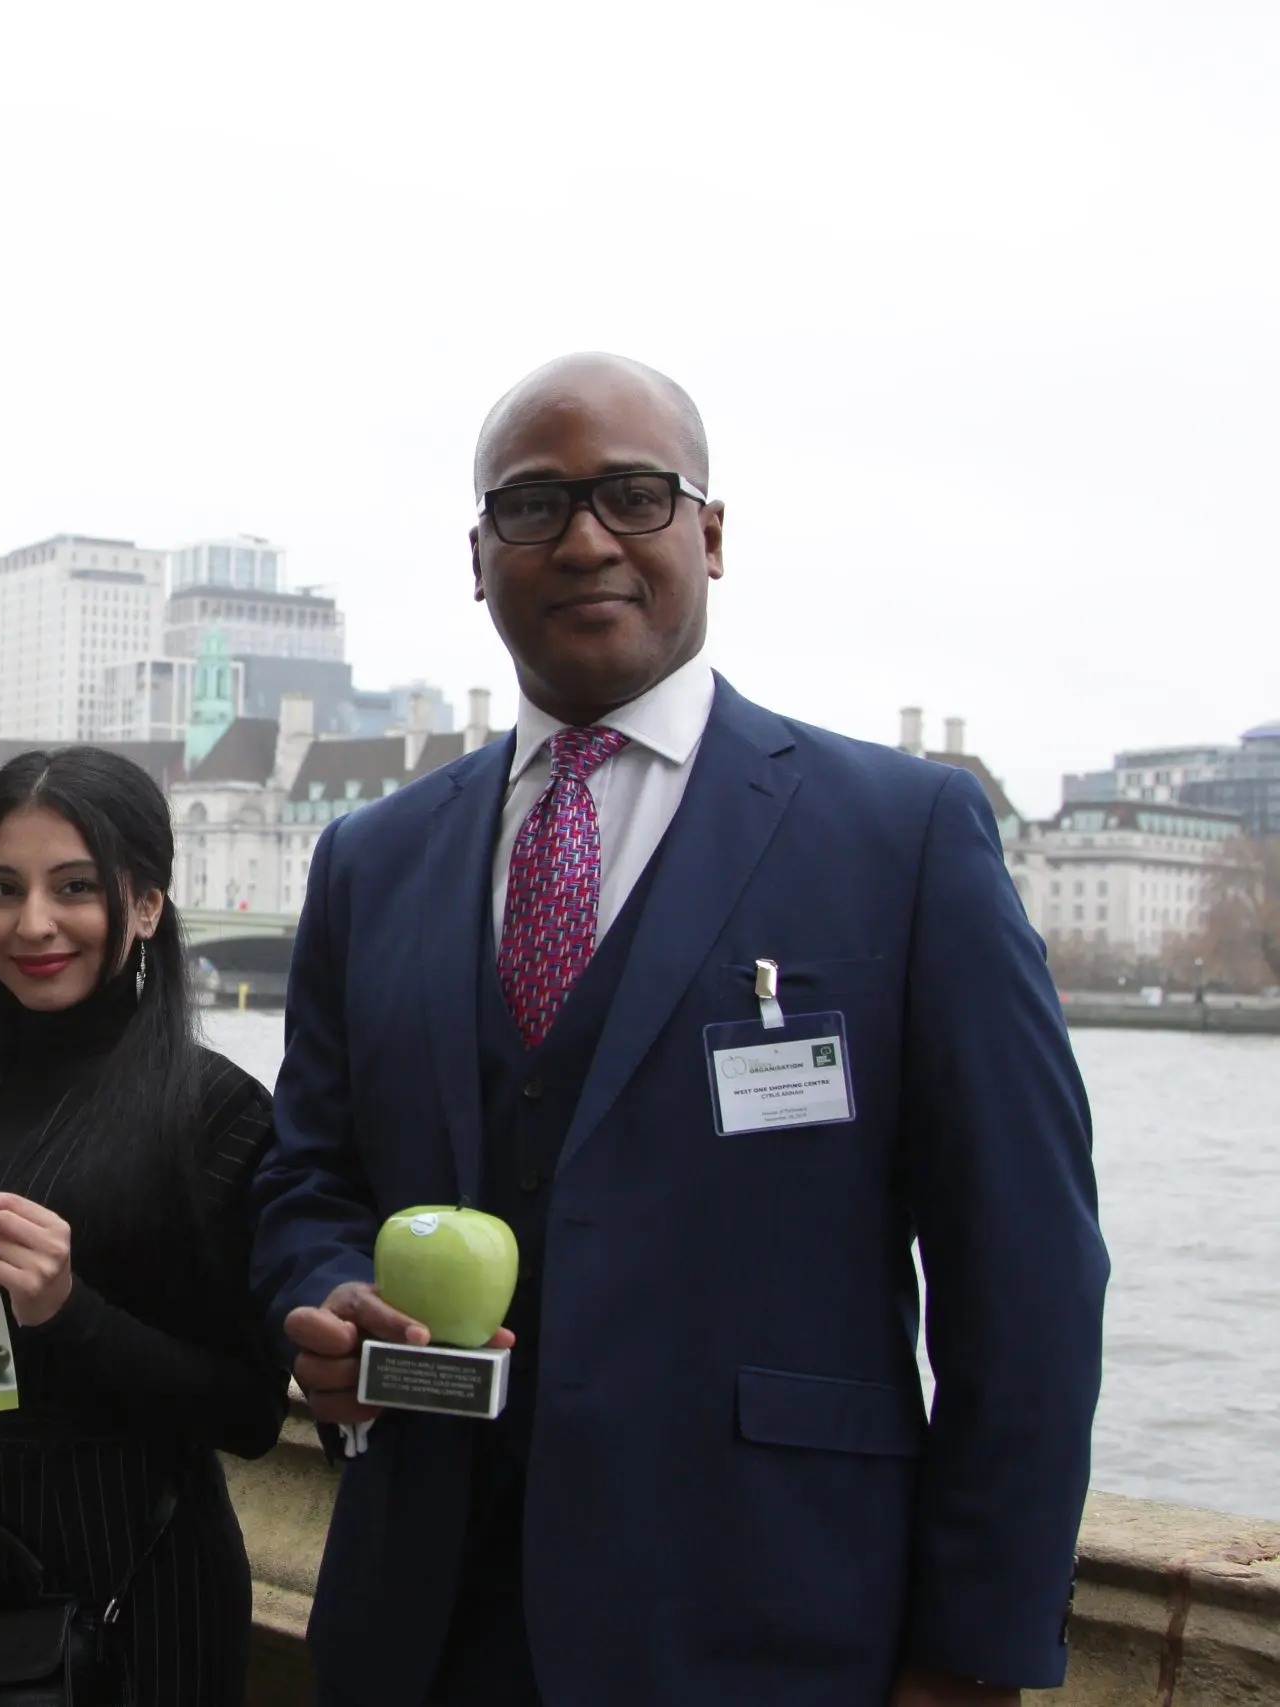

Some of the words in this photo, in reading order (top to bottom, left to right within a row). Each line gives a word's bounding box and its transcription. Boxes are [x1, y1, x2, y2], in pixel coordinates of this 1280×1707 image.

[733, 1088, 751, 1096] WEST
[768, 1082, 802, 1091] SHOPPING
[803, 1079, 830, 1087] CENTRE
